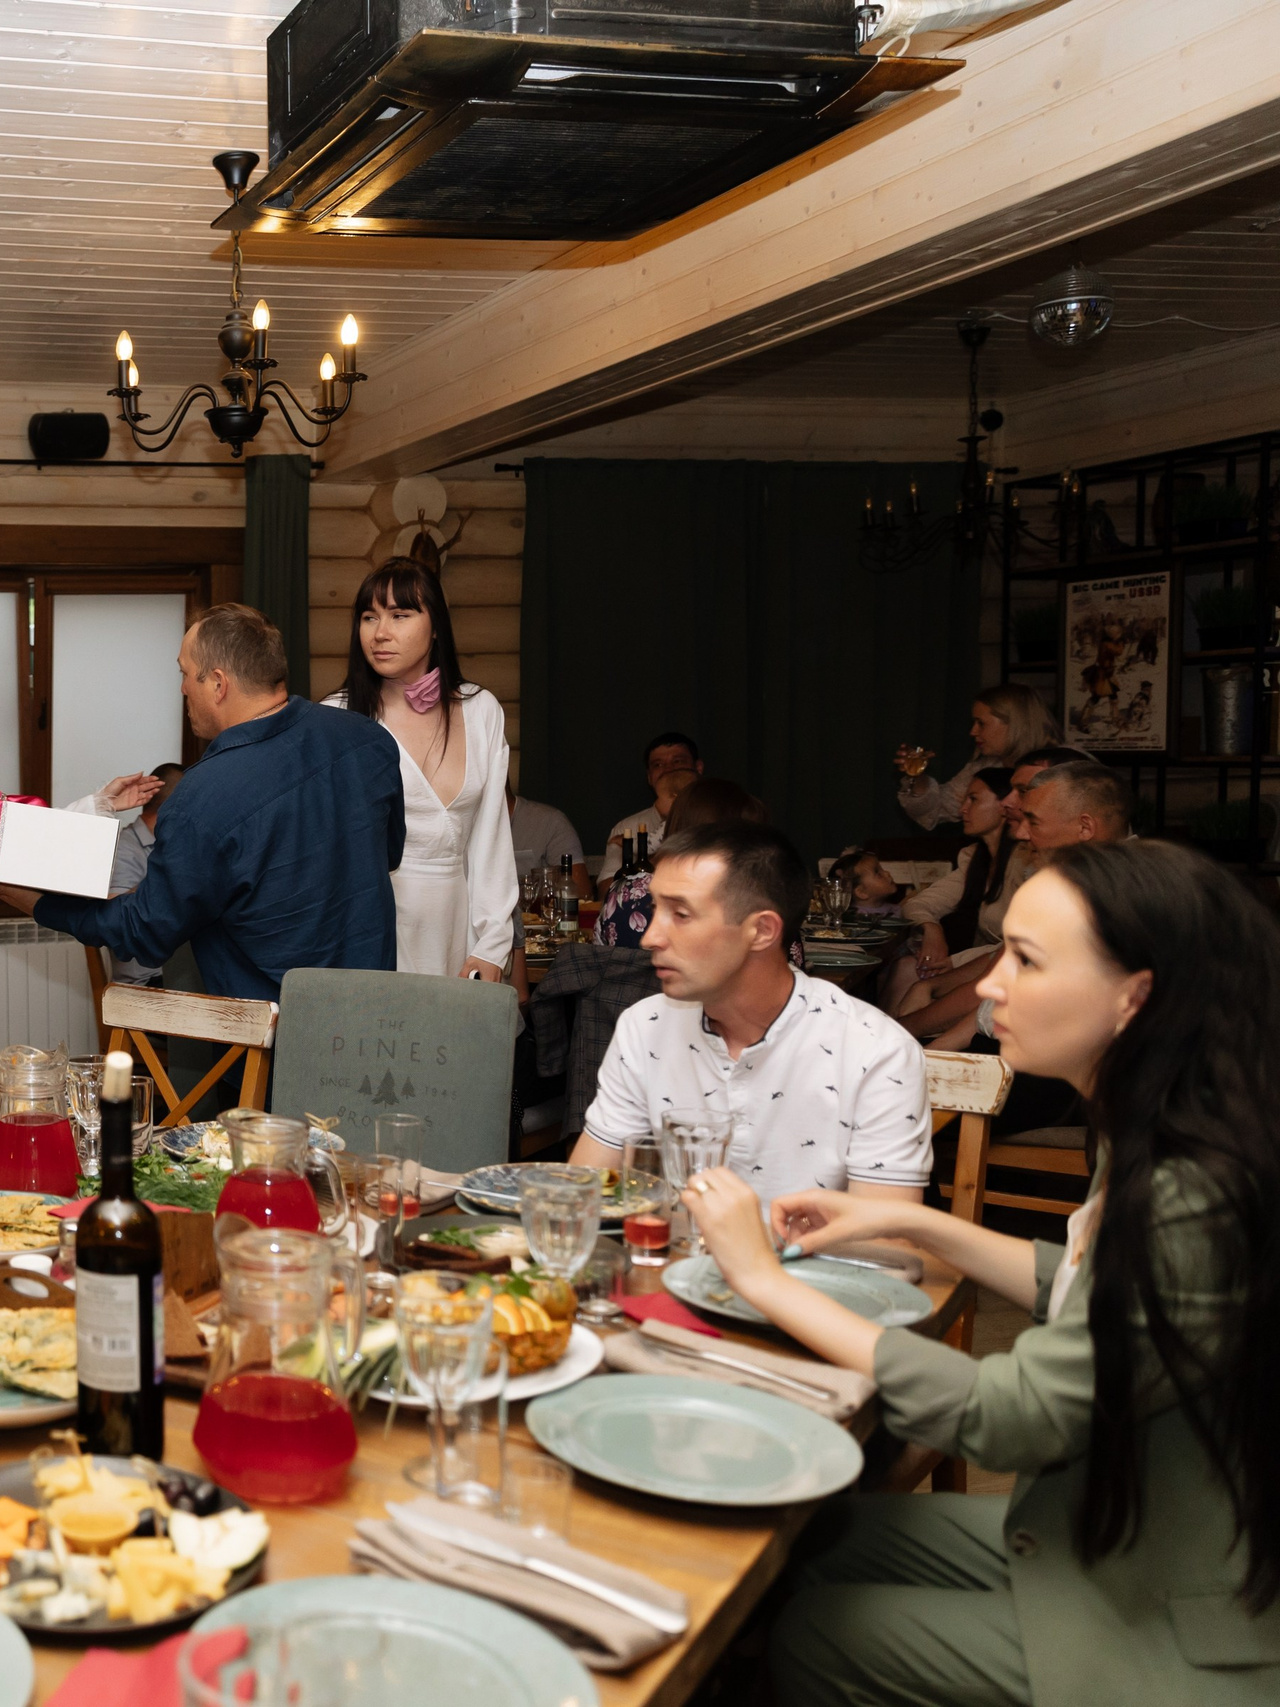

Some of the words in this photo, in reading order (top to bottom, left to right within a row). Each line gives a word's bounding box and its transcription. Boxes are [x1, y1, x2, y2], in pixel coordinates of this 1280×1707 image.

[1073, 584, 1089, 593] BIG
[1092, 580, 1119, 591] GAME
[1123, 575, 1166, 587] HUNTING
[1129, 585, 1161, 598] USSR
[377, 1019, 405, 1031] THE
[332, 1036, 447, 1065] PINES
[319, 1078, 351, 1088] SINCE
